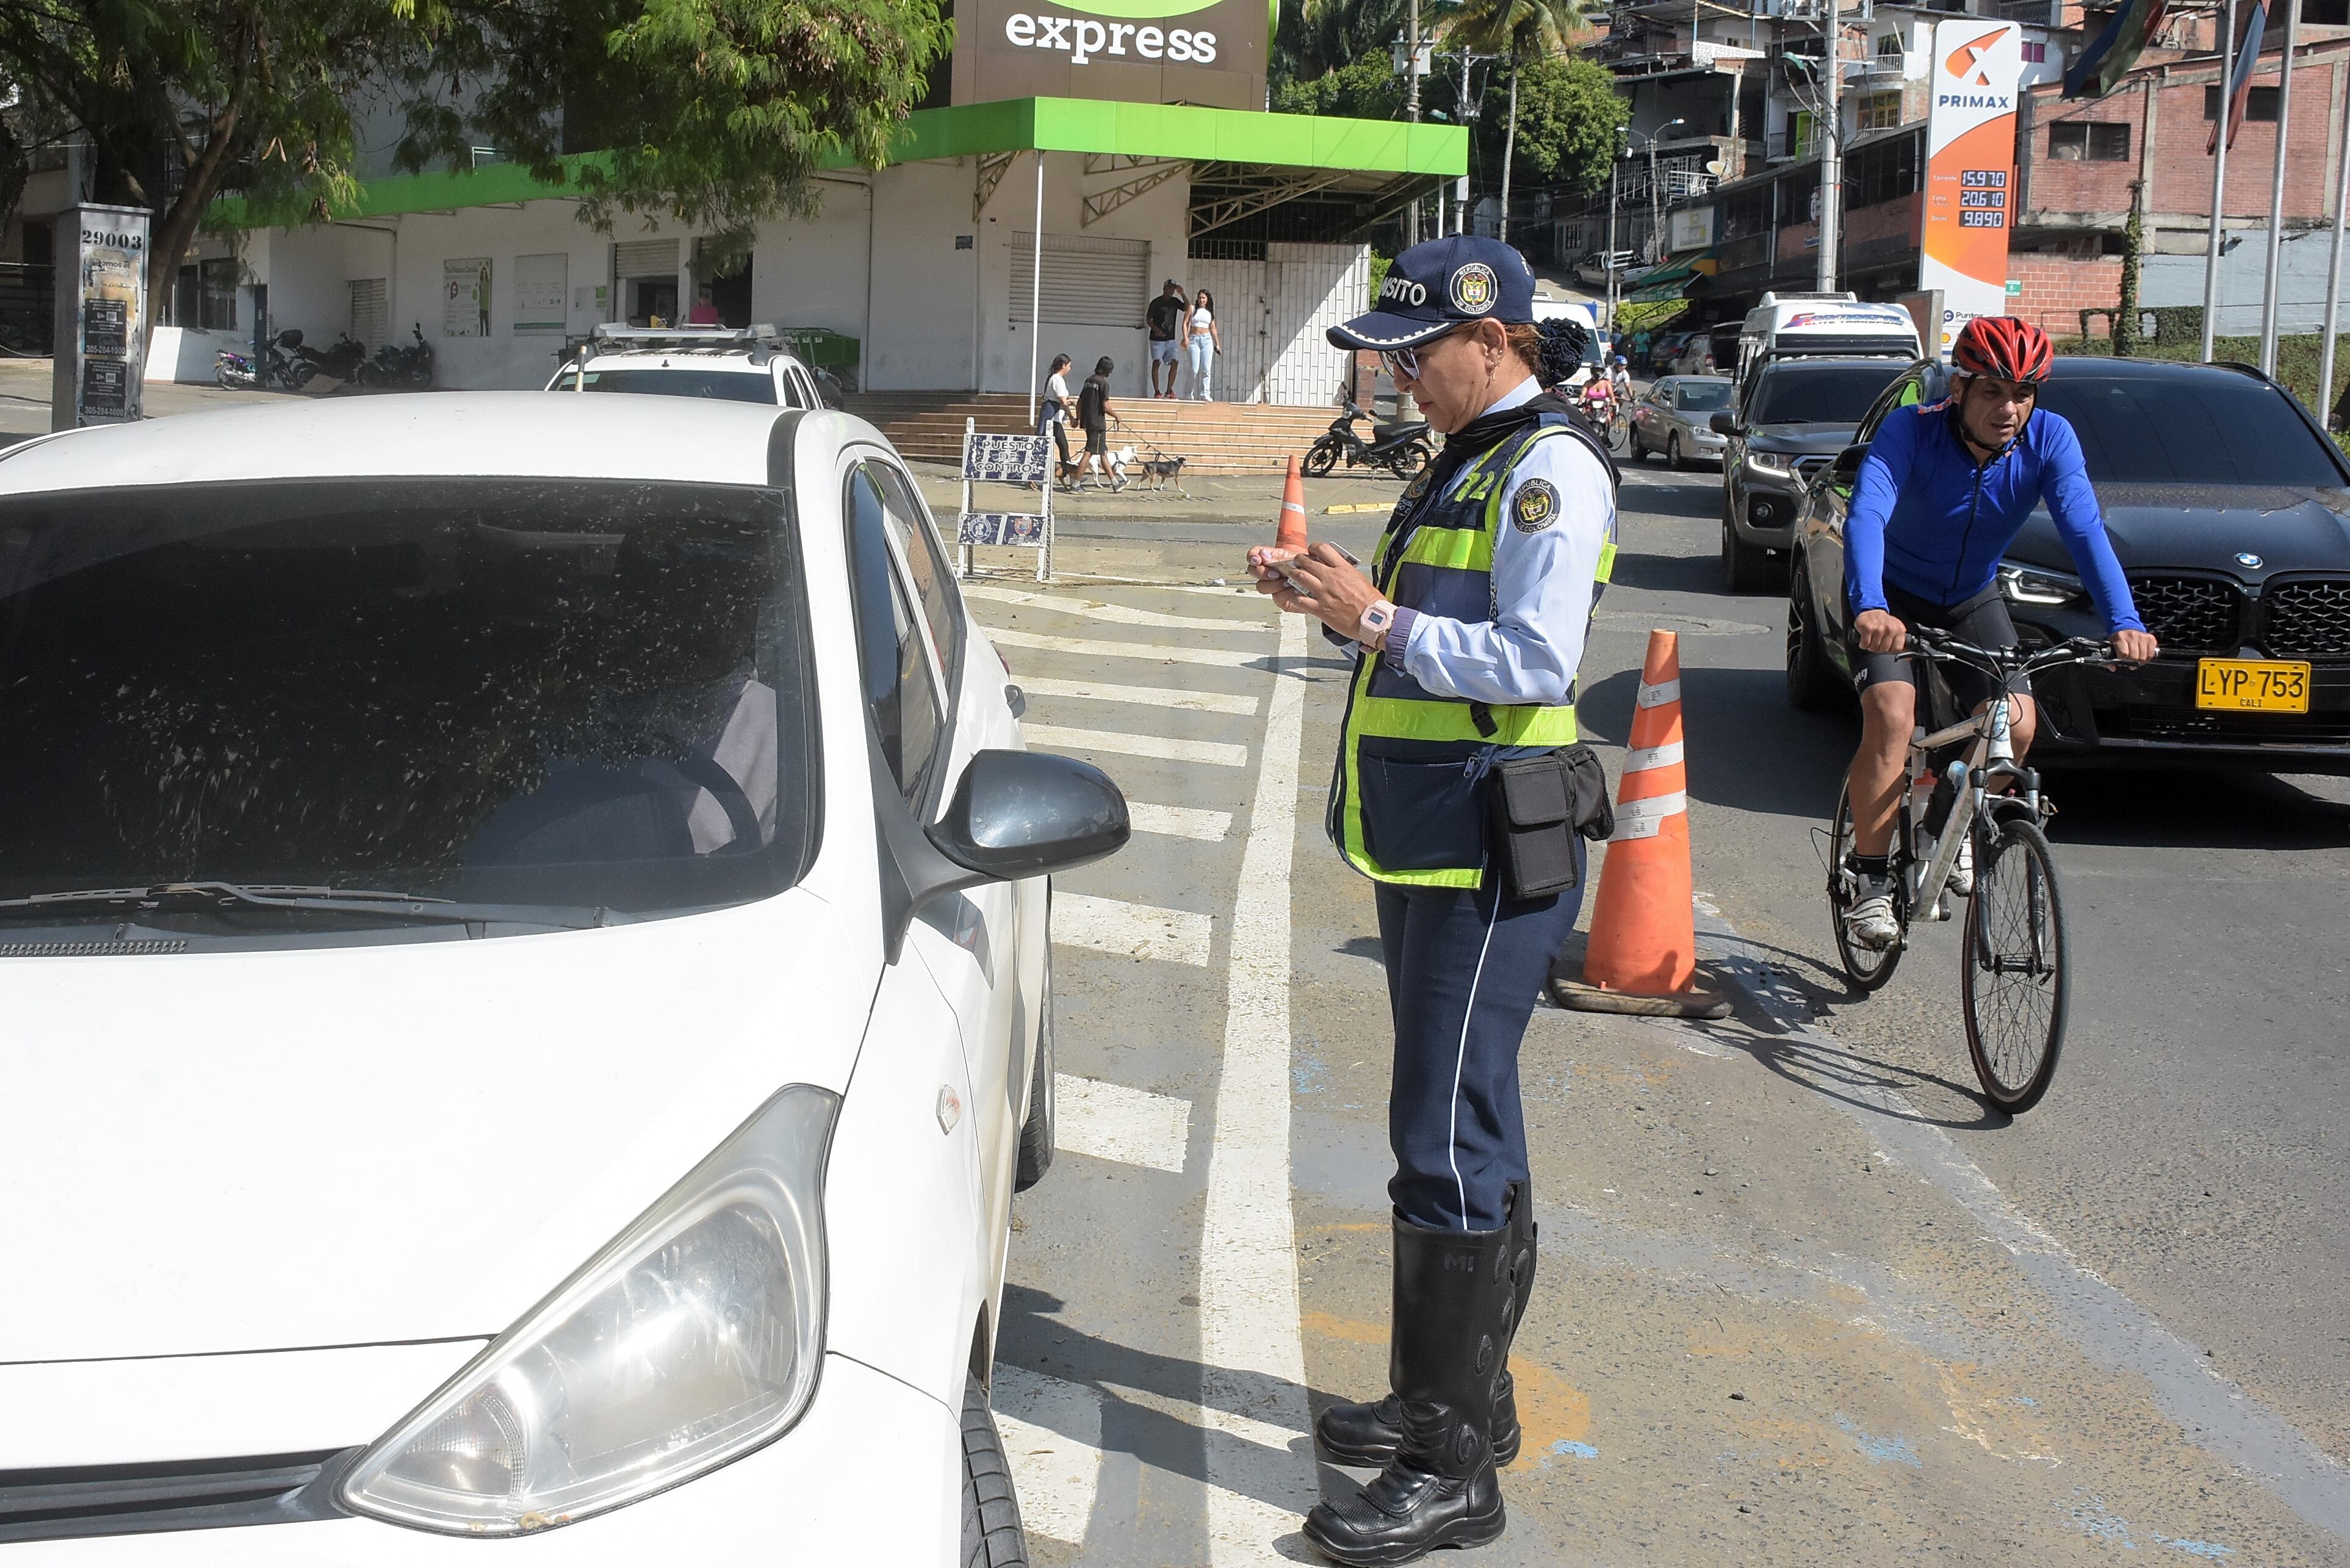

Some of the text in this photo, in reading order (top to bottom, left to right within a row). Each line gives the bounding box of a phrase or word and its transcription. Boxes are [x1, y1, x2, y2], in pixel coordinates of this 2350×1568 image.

[1006, 13, 1216, 65] express
[1939, 95, 2009, 108] PRIMAX
[82, 230, 142, 250] 29003
[1465, 300, 1493, 312] COLOMBIA
[86, 345, 126, 354] 305-284-1000
[85, 406, 124, 416] 305-284-1000
[983, 440, 1036, 451] PUESTO
[998, 451, 1018, 462] DE
[976, 462, 1040, 474] CONTROL
[1517, 513, 1557, 532] DE COLOMBIA
[2201, 668, 2305, 698] LYP 753
[2240, 698, 2263, 708] CALI
